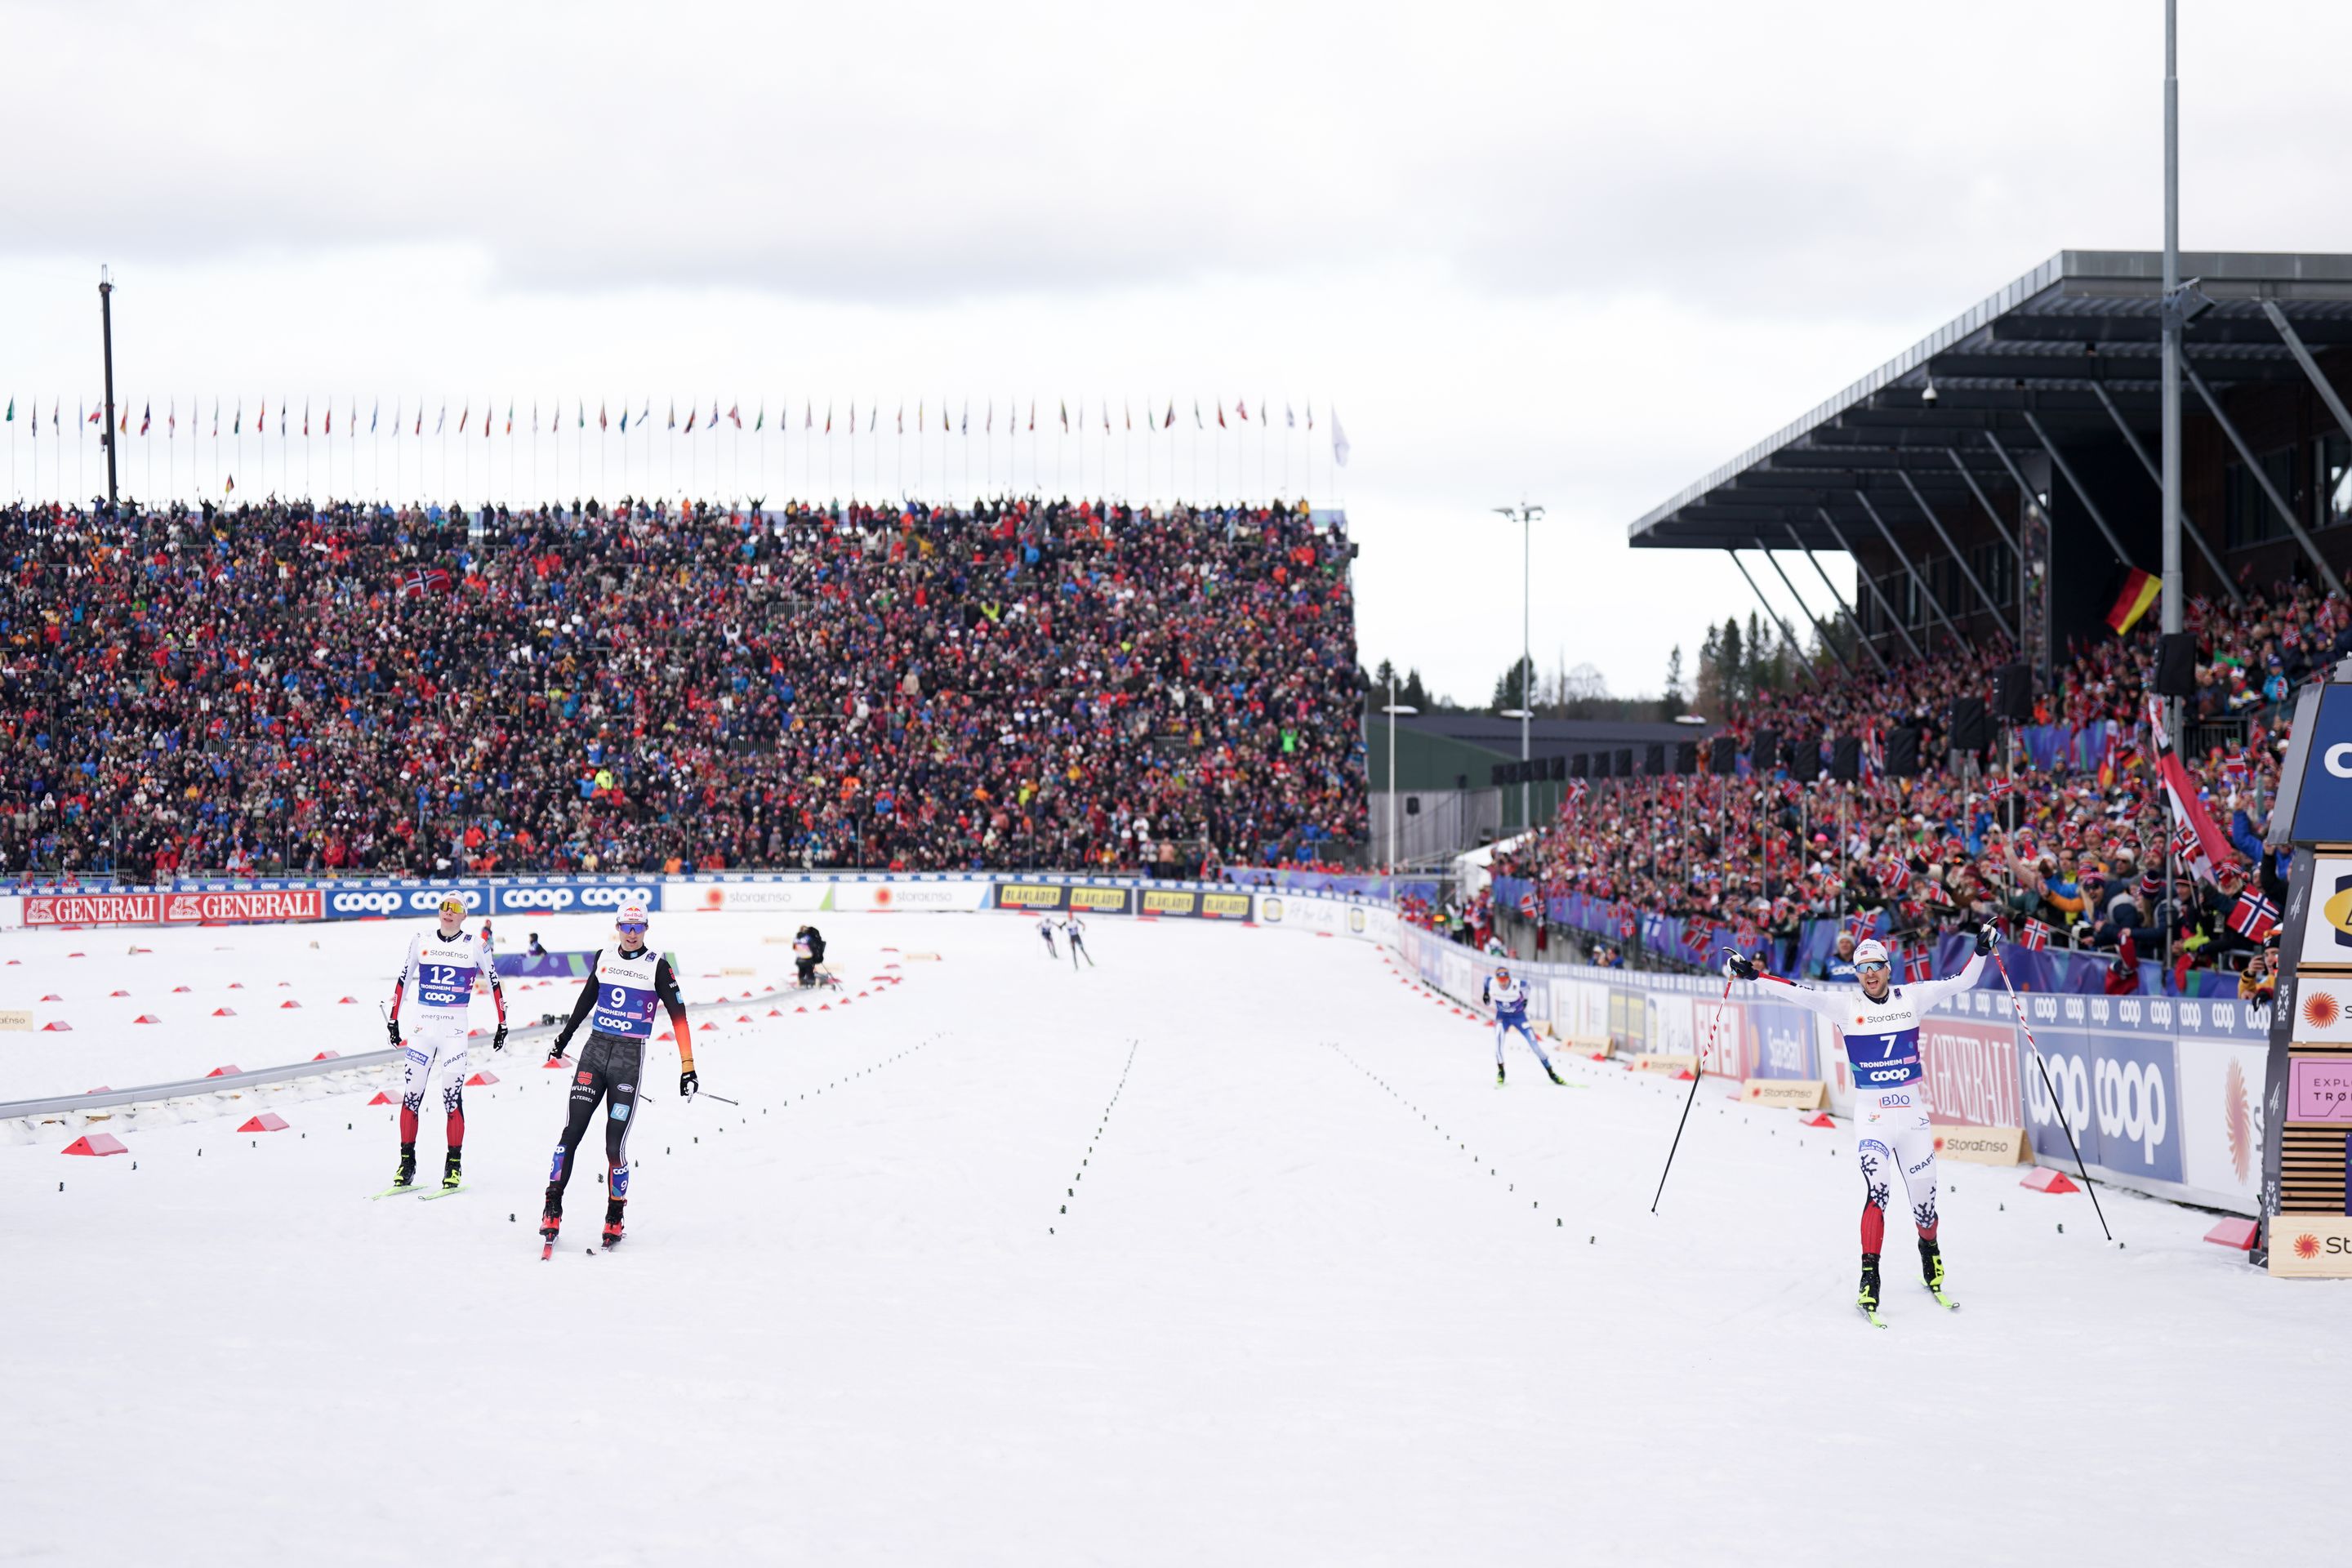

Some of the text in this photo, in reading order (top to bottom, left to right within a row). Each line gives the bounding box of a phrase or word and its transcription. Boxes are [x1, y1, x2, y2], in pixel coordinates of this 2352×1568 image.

[203, 893, 316, 919] GENERALI
[333, 892, 403, 915] coop
[503, 887, 574, 911] coop
[56, 897, 155, 923] GENERALI
[430, 950, 469, 960] StoraEnso
[430, 966, 456, 985] 12
[608, 967, 648, 981] StoraEnso
[425, 991, 456, 1003] coop
[611, 987, 626, 1008] 9
[647, 1001, 653, 1013] 9
[1867, 1011, 1912, 1023] StoraEnso
[2035, 997, 2057, 1024] coop
[2065, 998, 2084, 1025] coop
[2091, 998, 2109, 1026] coop
[2119, 1000, 2141, 1029] coop
[2150, 1001, 2172, 1031] coop
[2180, 1003, 2202, 1032] coop
[2212, 1003, 2234, 1034] coop
[598, 1016, 632, 1032] coop
[1880, 1035, 1897, 1058] 7
[443, 1052, 464, 1067] CRAFT
[1859, 1058, 1903, 1068] TRONDHEIM
[1870, 1067, 1910, 1081] coop
[1931, 1034, 2017, 1129] GENERALI
[2314, 1078, 2352, 1087] EXPL
[1882, 1094, 1910, 1106] BDO
[2025, 1052, 2090, 1150] coop
[2314, 1093, 2352, 1101] TRØ
[2095, 1057, 2166, 1165] coop
[1947, 1138, 2008, 1153] StoraEnso
[1909, 1153, 1935, 1174] CRAFT
[621, 1180, 627, 1191] 9
